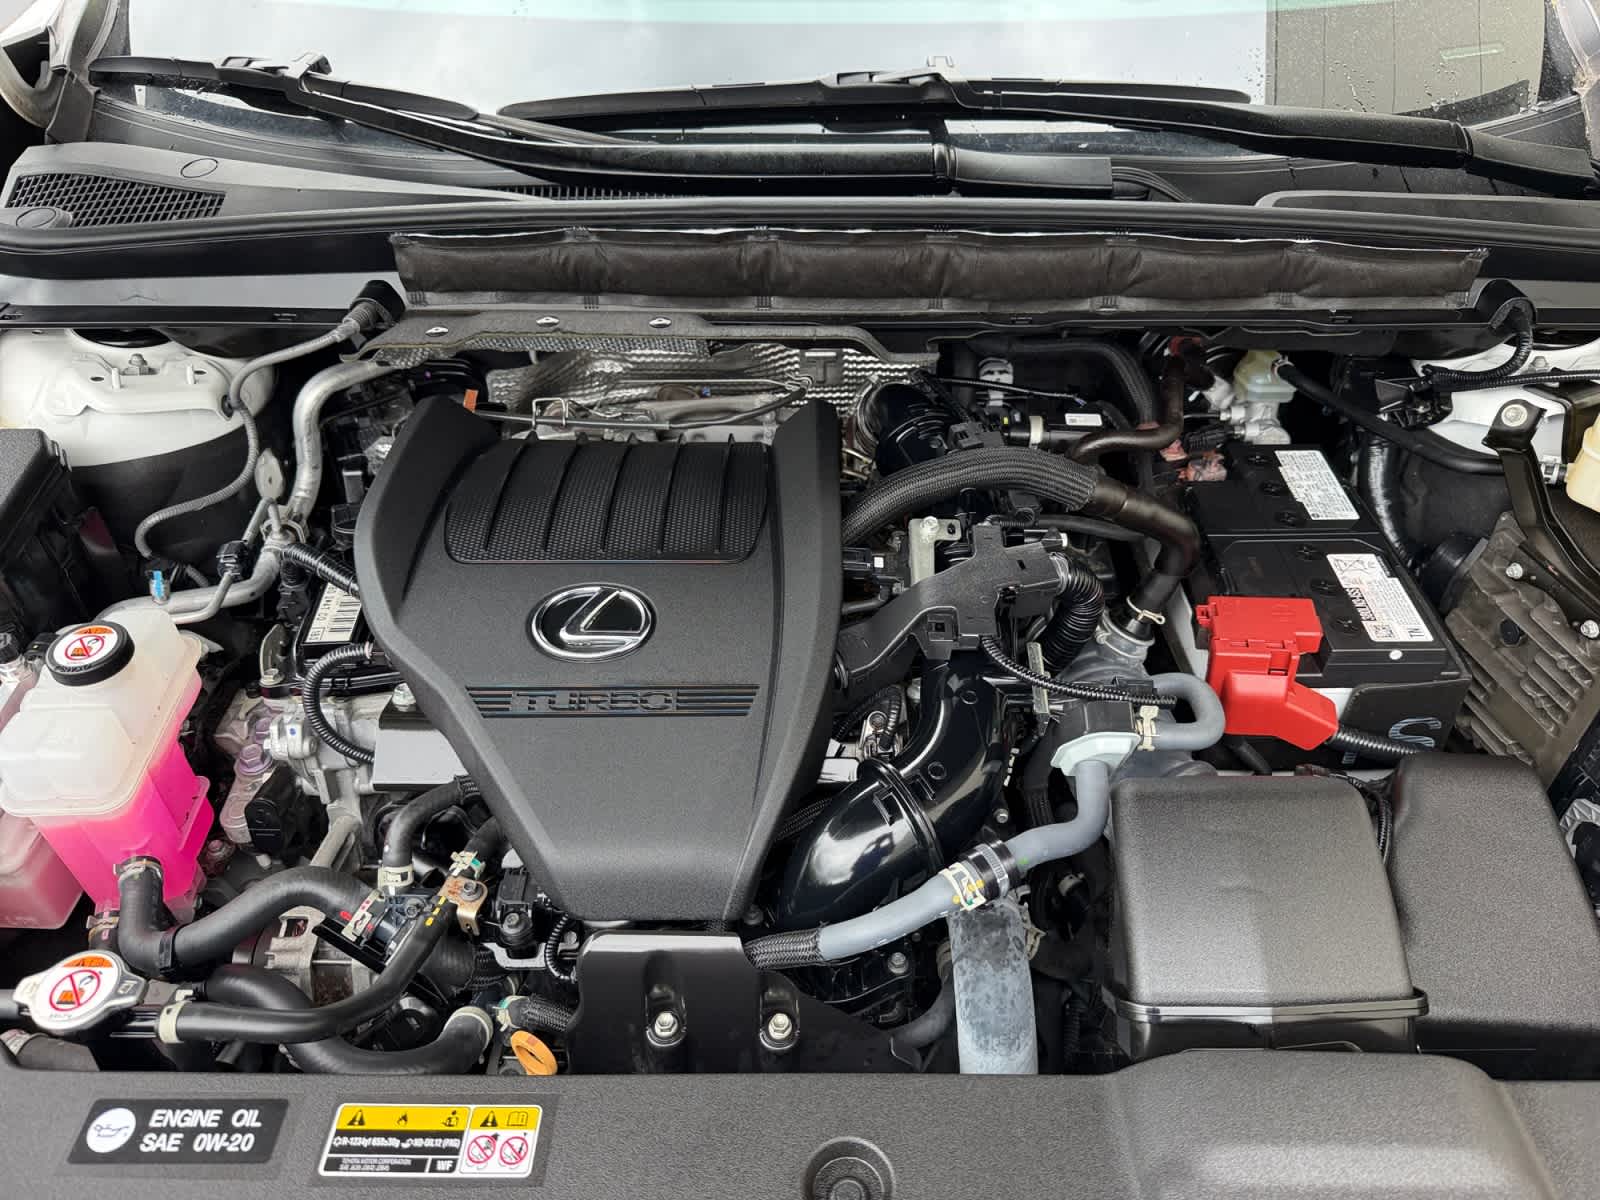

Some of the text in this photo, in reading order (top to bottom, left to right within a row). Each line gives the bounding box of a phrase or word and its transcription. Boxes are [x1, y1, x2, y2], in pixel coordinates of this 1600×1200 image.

[515, 691, 673, 711] TURBO
[149, 1109, 262, 1128] ENGINE OIL
[139, 1133, 255, 1152] SAE 0W-20
